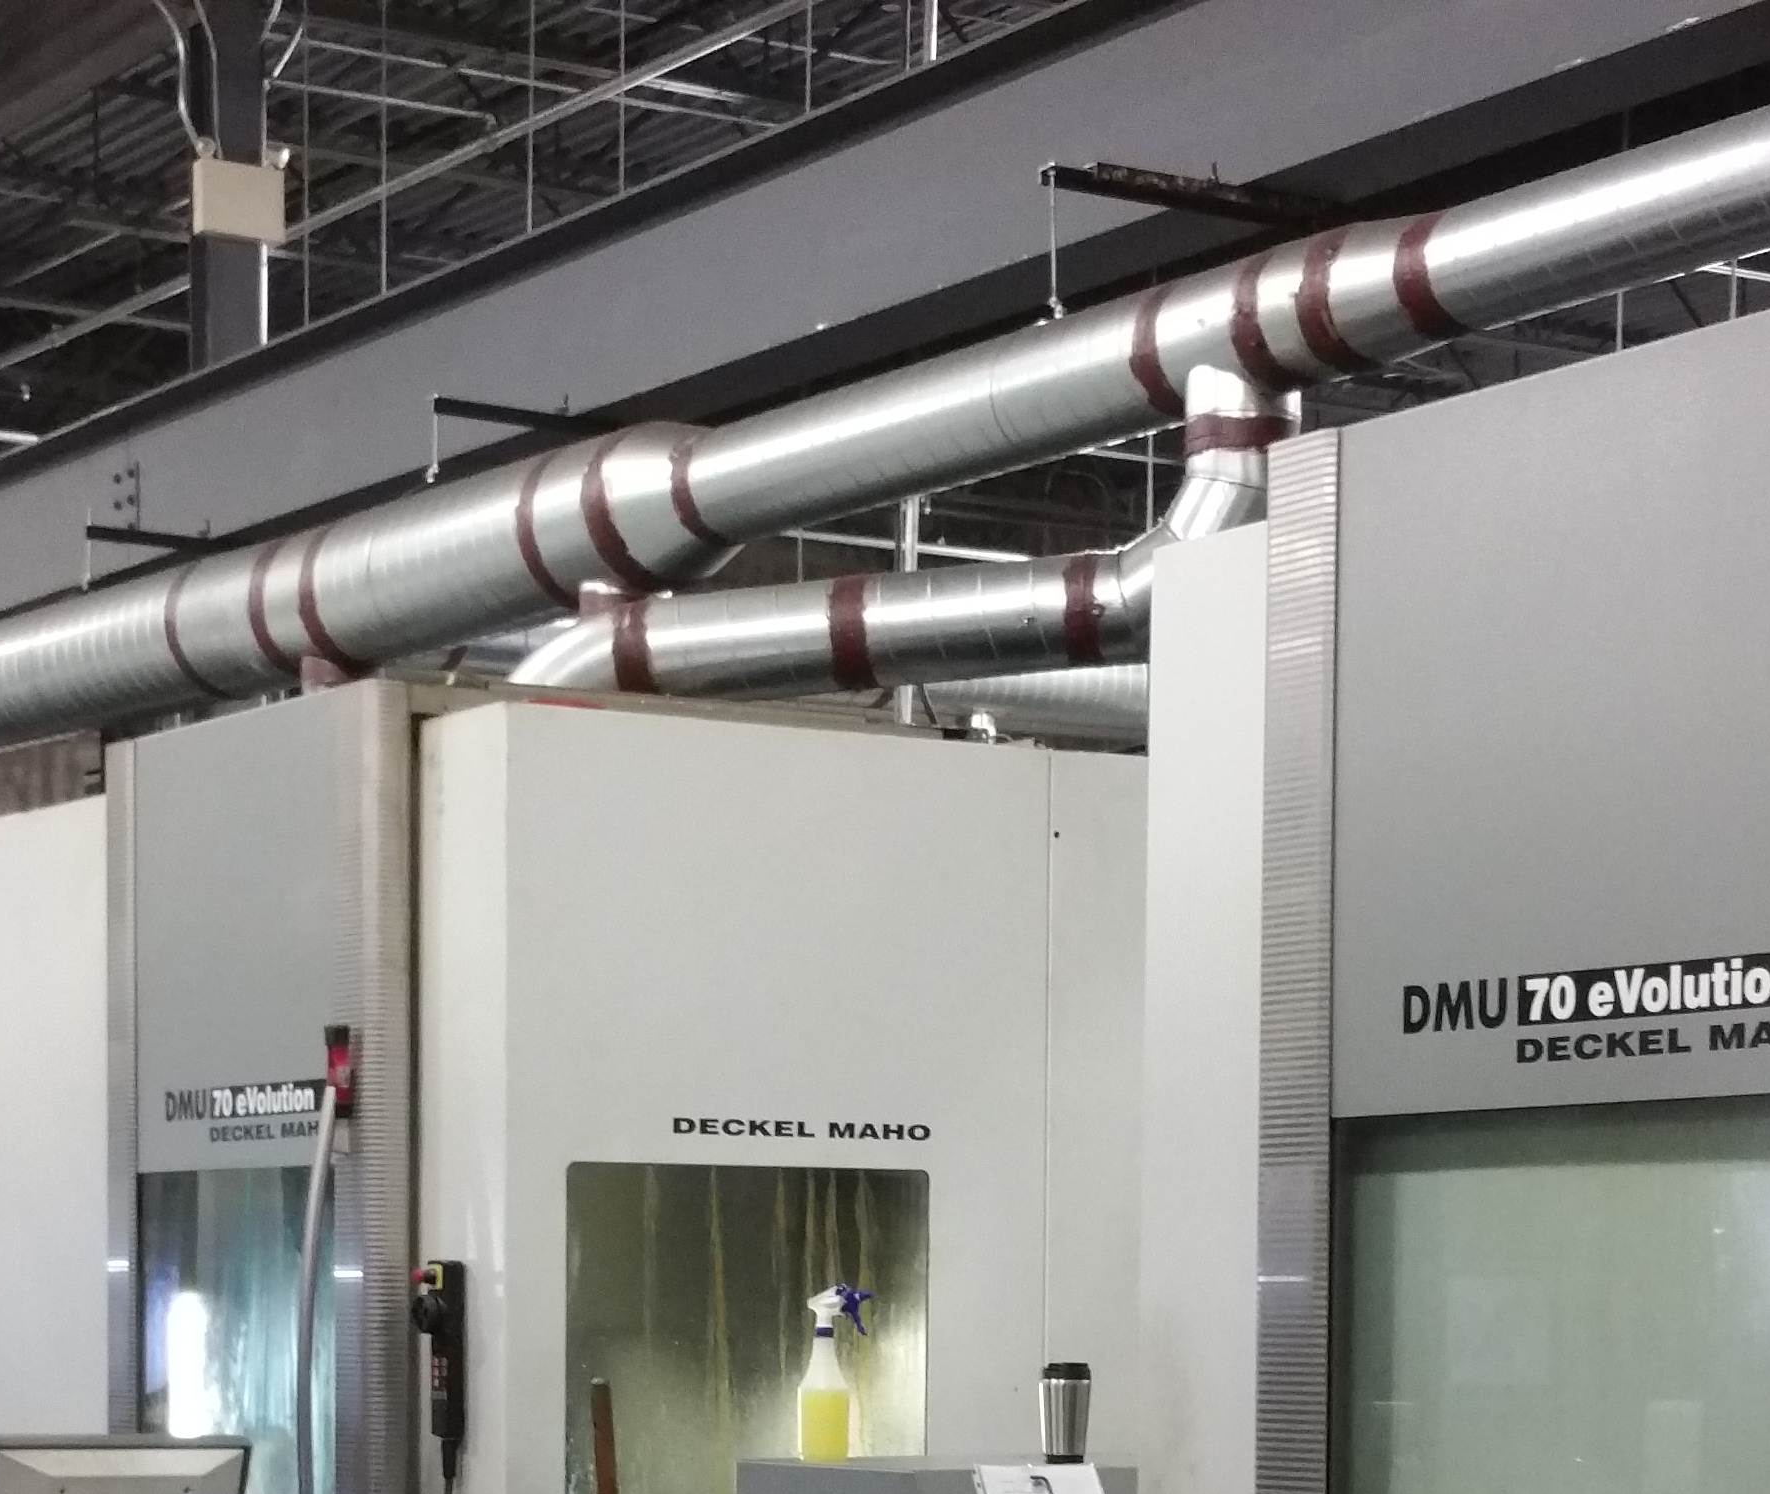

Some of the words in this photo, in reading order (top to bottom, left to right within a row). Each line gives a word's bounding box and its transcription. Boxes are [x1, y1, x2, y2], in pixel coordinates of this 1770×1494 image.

[1403, 979, 1507, 1034] DMU
[1525, 975, 1576, 1021] 70
[1516, 1028, 1691, 1063] DECKEL
[165, 1089, 206, 1121] DMU
[212, 1089, 233, 1117] 70
[236, 1083, 315, 1116] eVolution
[209, 1124, 275, 1142] DECKEL
[281, 1121, 319, 1138] MAH
[672, 1117, 815, 1138] DECKEL
[828, 1122, 931, 1141] MAHO
